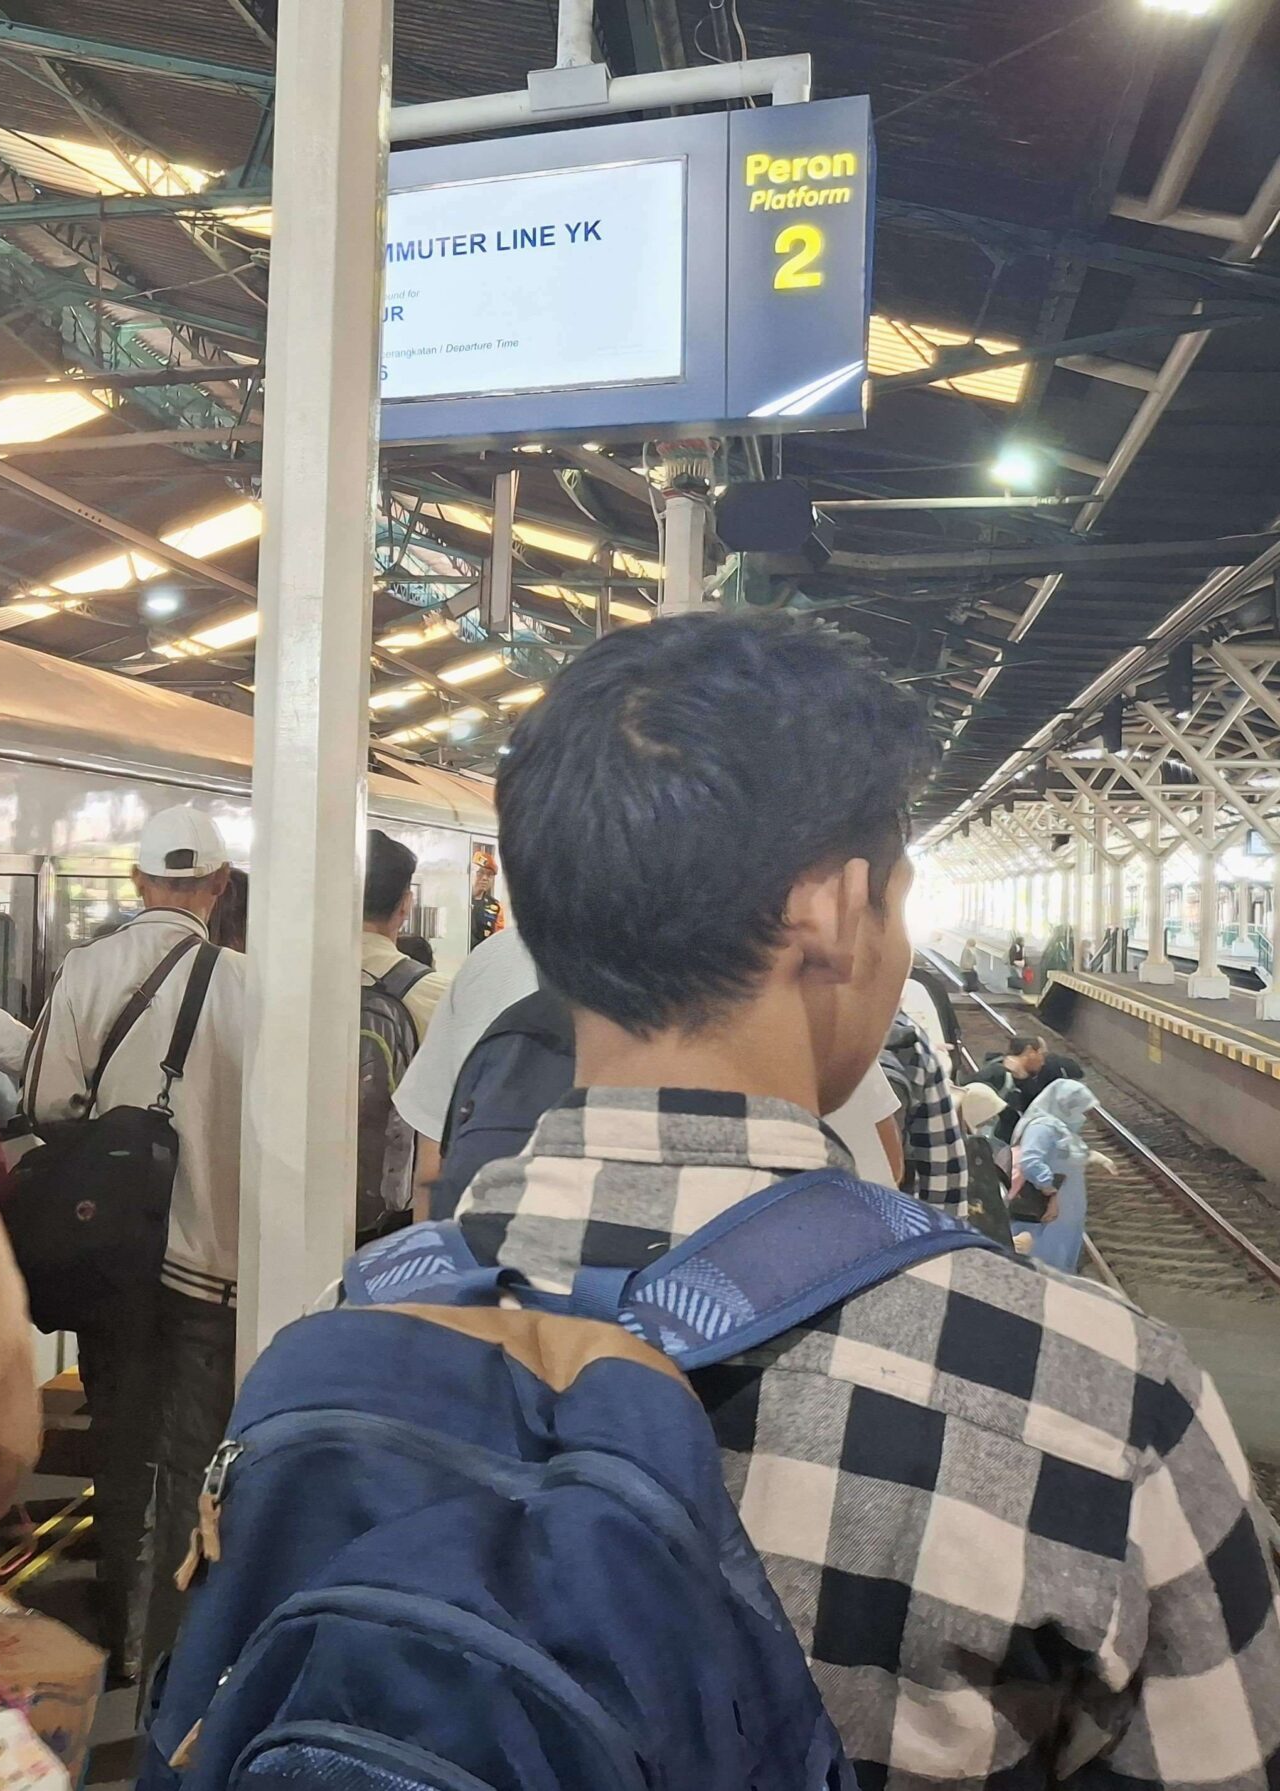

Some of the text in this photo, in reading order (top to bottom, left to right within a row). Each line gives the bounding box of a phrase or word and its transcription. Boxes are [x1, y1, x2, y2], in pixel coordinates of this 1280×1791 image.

[746, 153, 855, 186] Peron
[749, 186, 850, 212] Platform
[496, 225, 555, 251] LINE
[565, 220, 602, 243] YK
[774, 225, 821, 289] 2
[407, 289, 420, 299] for
[445, 341, 492, 354] Departure
[496, 338, 519, 349] Time
